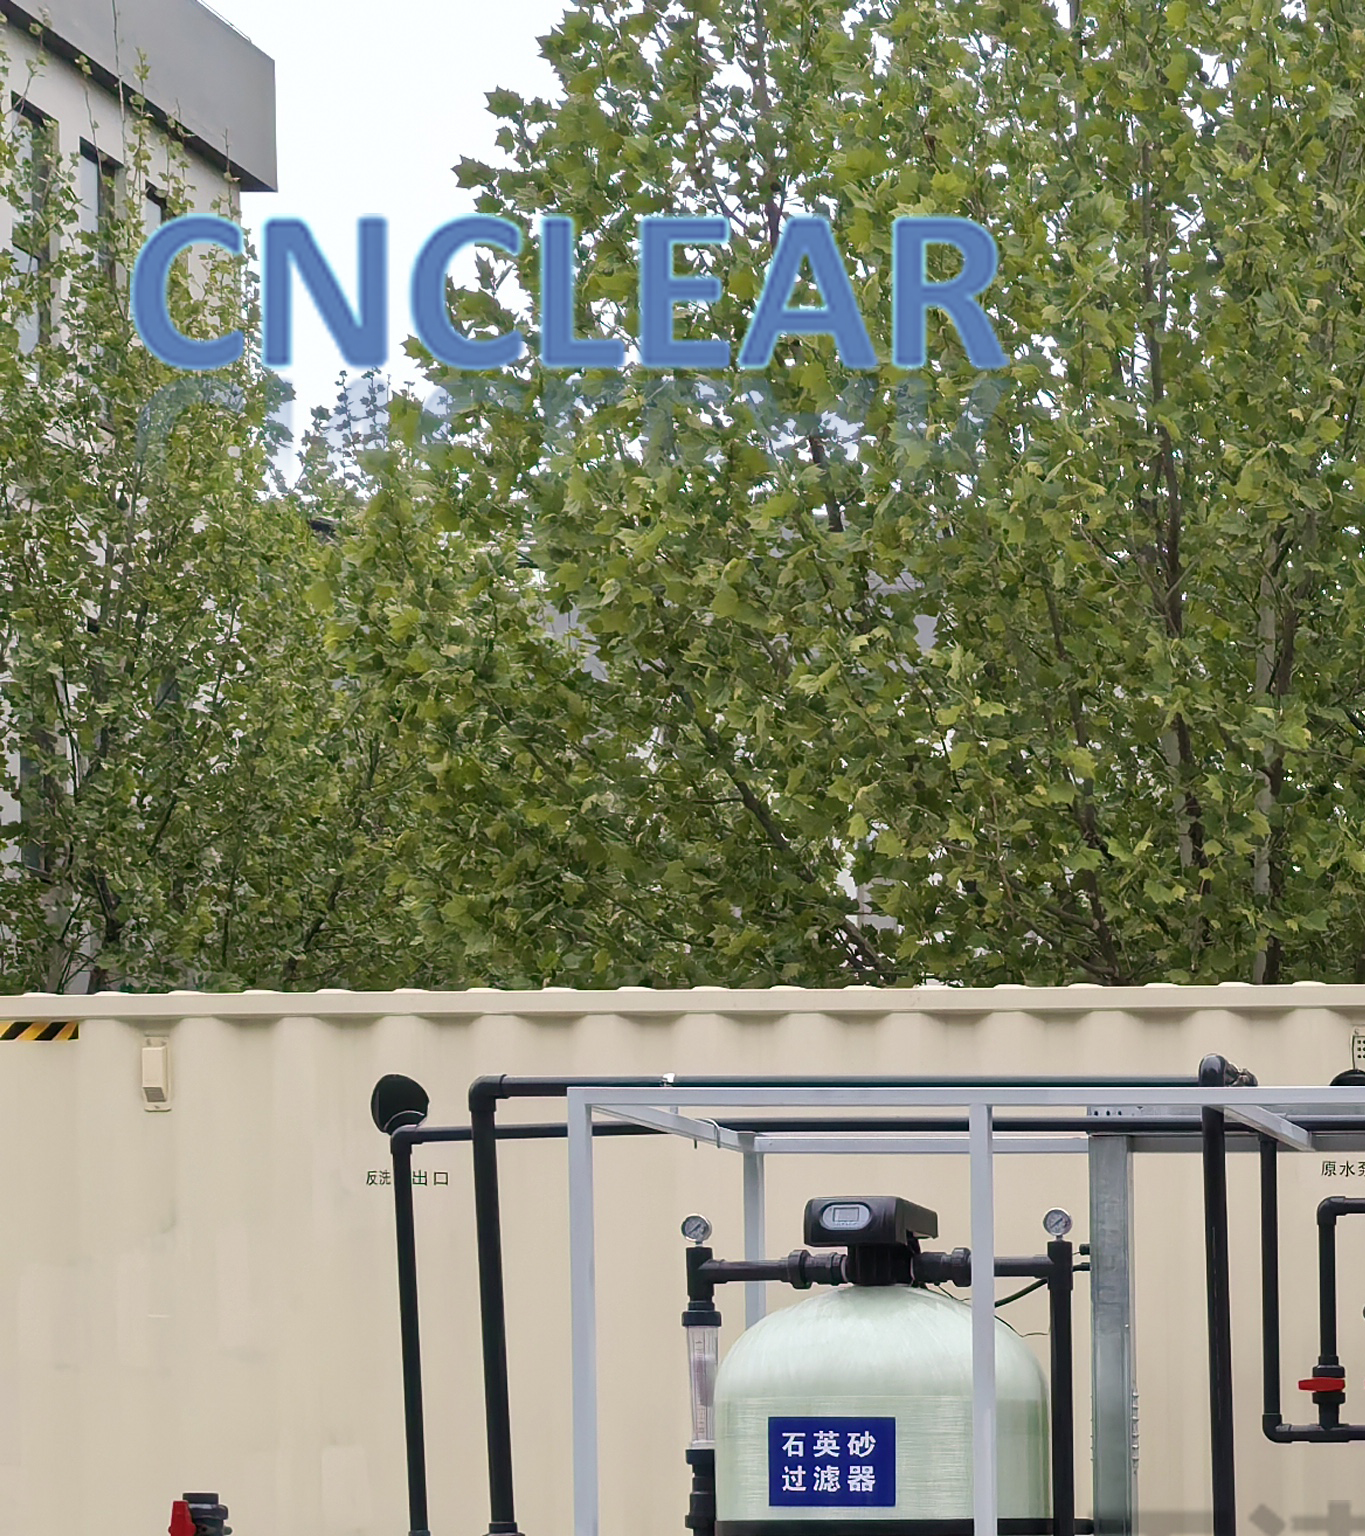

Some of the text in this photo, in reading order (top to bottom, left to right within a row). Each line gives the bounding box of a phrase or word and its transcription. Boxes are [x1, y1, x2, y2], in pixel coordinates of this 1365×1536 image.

[366, 1169, 448, 1186] 反洗出口
[782, 1430, 876, 1457] 石英砂
[782, 1465, 876, 1492] 过滤器
